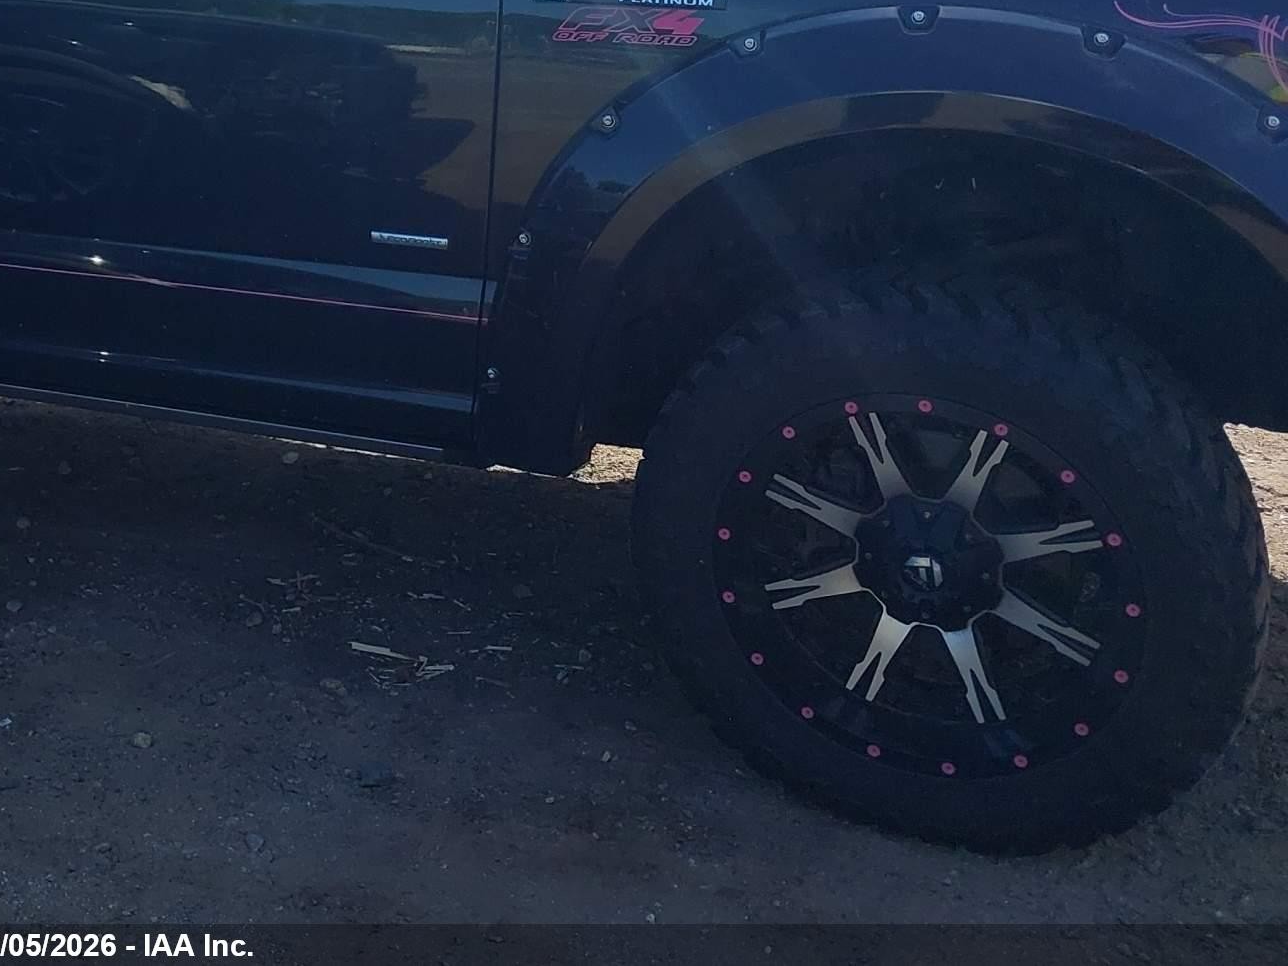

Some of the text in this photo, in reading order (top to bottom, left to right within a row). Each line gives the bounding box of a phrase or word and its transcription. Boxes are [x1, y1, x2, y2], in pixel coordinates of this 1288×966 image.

[558, 6, 705, 35] FX4
[552, 30, 698, 47] OFF ROAD
